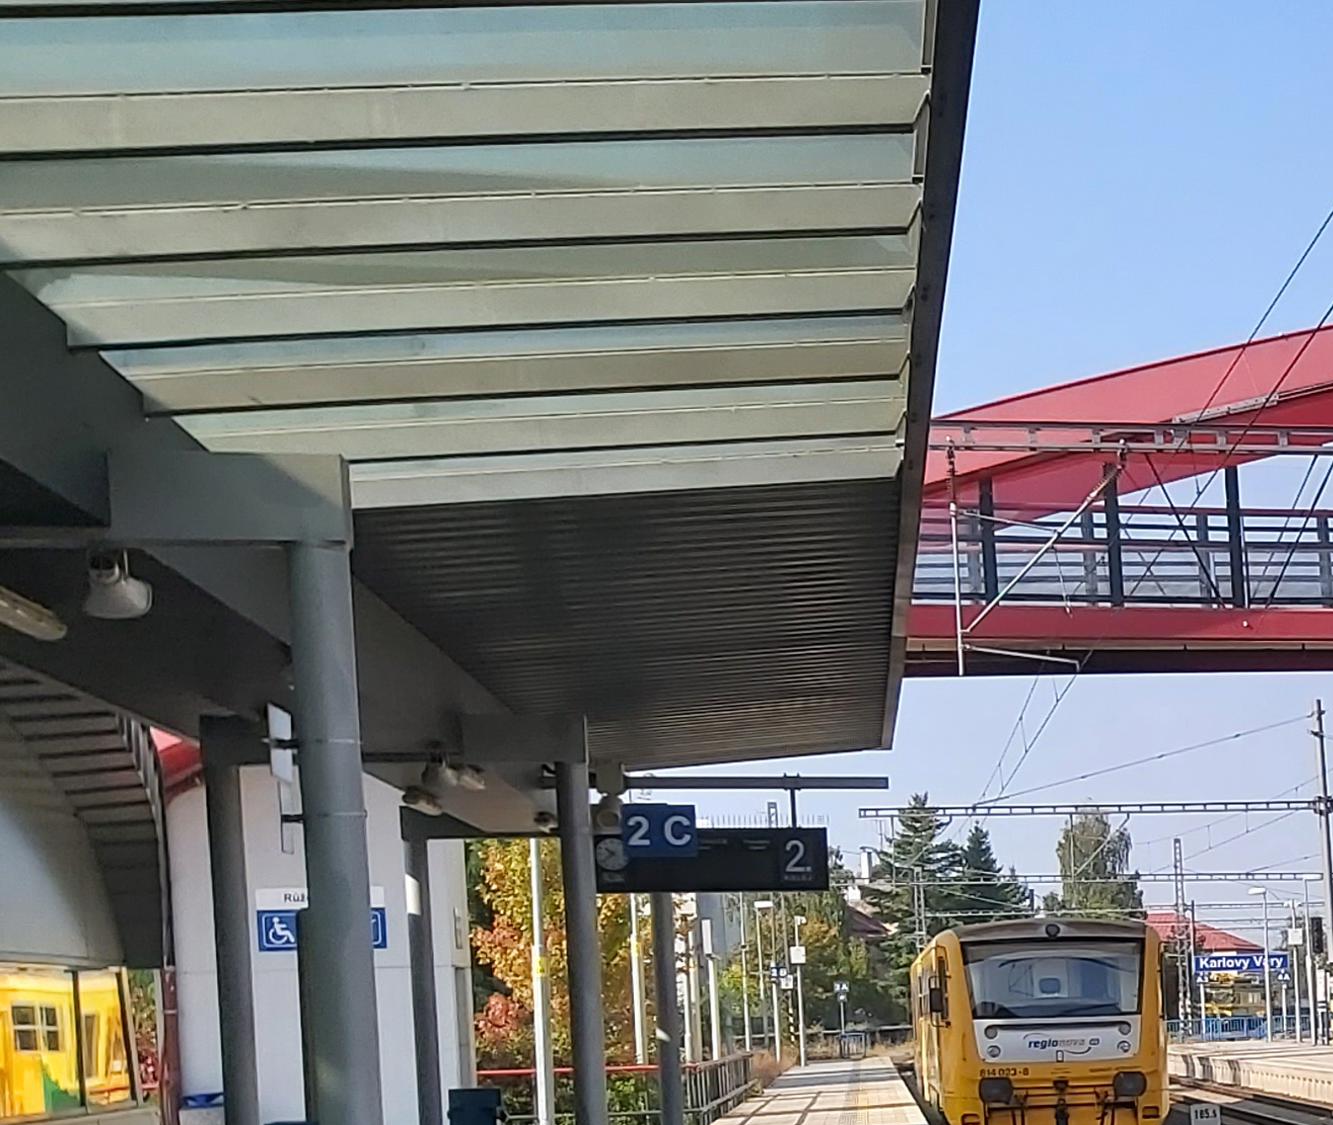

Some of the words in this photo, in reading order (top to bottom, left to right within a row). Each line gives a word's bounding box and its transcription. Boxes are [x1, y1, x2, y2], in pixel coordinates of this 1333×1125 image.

[627, 816, 650, 846] 2
[663, 815, 691, 846] C
[283, 892, 306, 902] Růž
[1199, 958, 1250, 970] Karlovy
[1252, 956, 1284, 967] Vry
